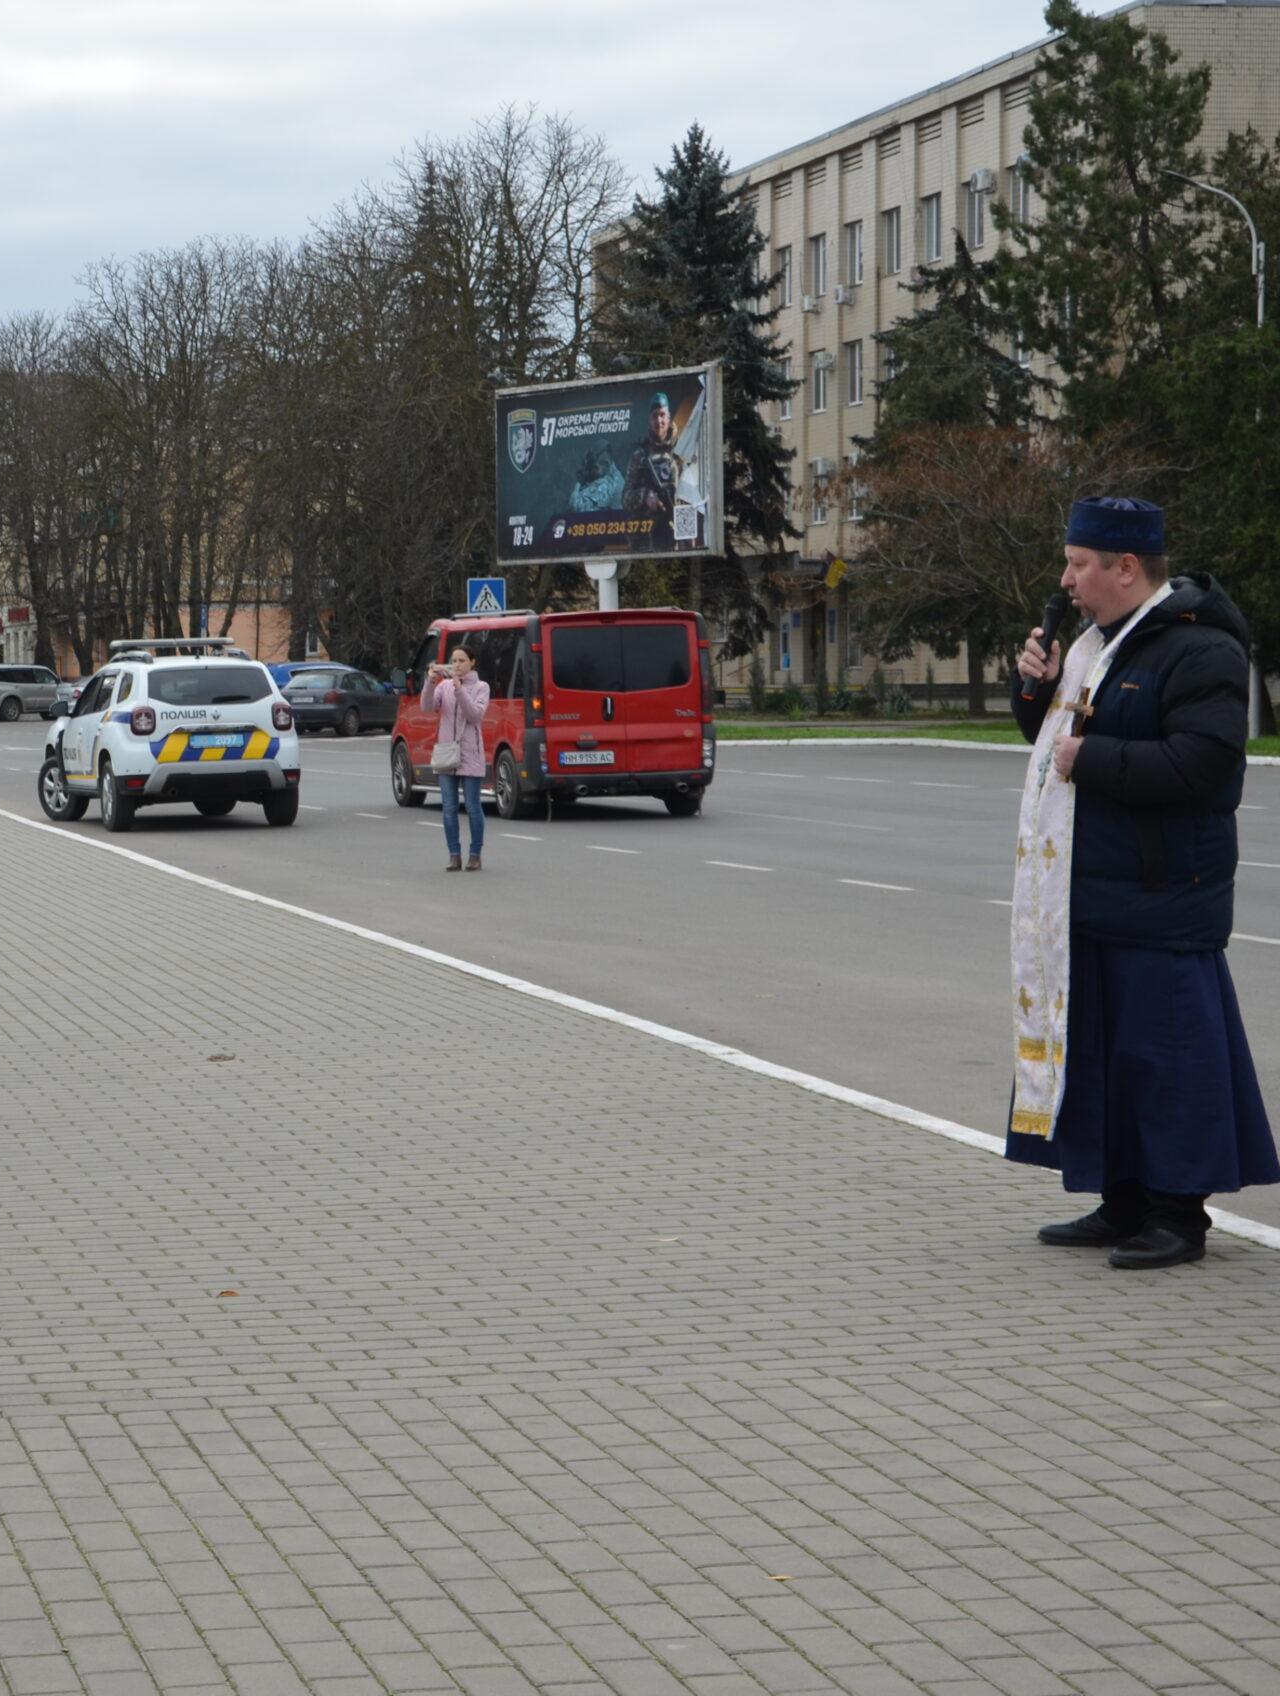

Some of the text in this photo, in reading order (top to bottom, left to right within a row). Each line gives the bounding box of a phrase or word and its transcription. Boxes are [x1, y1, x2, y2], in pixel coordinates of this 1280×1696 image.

[541, 409, 631, 446] 37 ОКРЕМА БРИГАДА
[555, 421, 630, 438] МОРСЬКОЇ ПІХОТИ
[567, 519, 654, 536] +38 050 234 37 37
